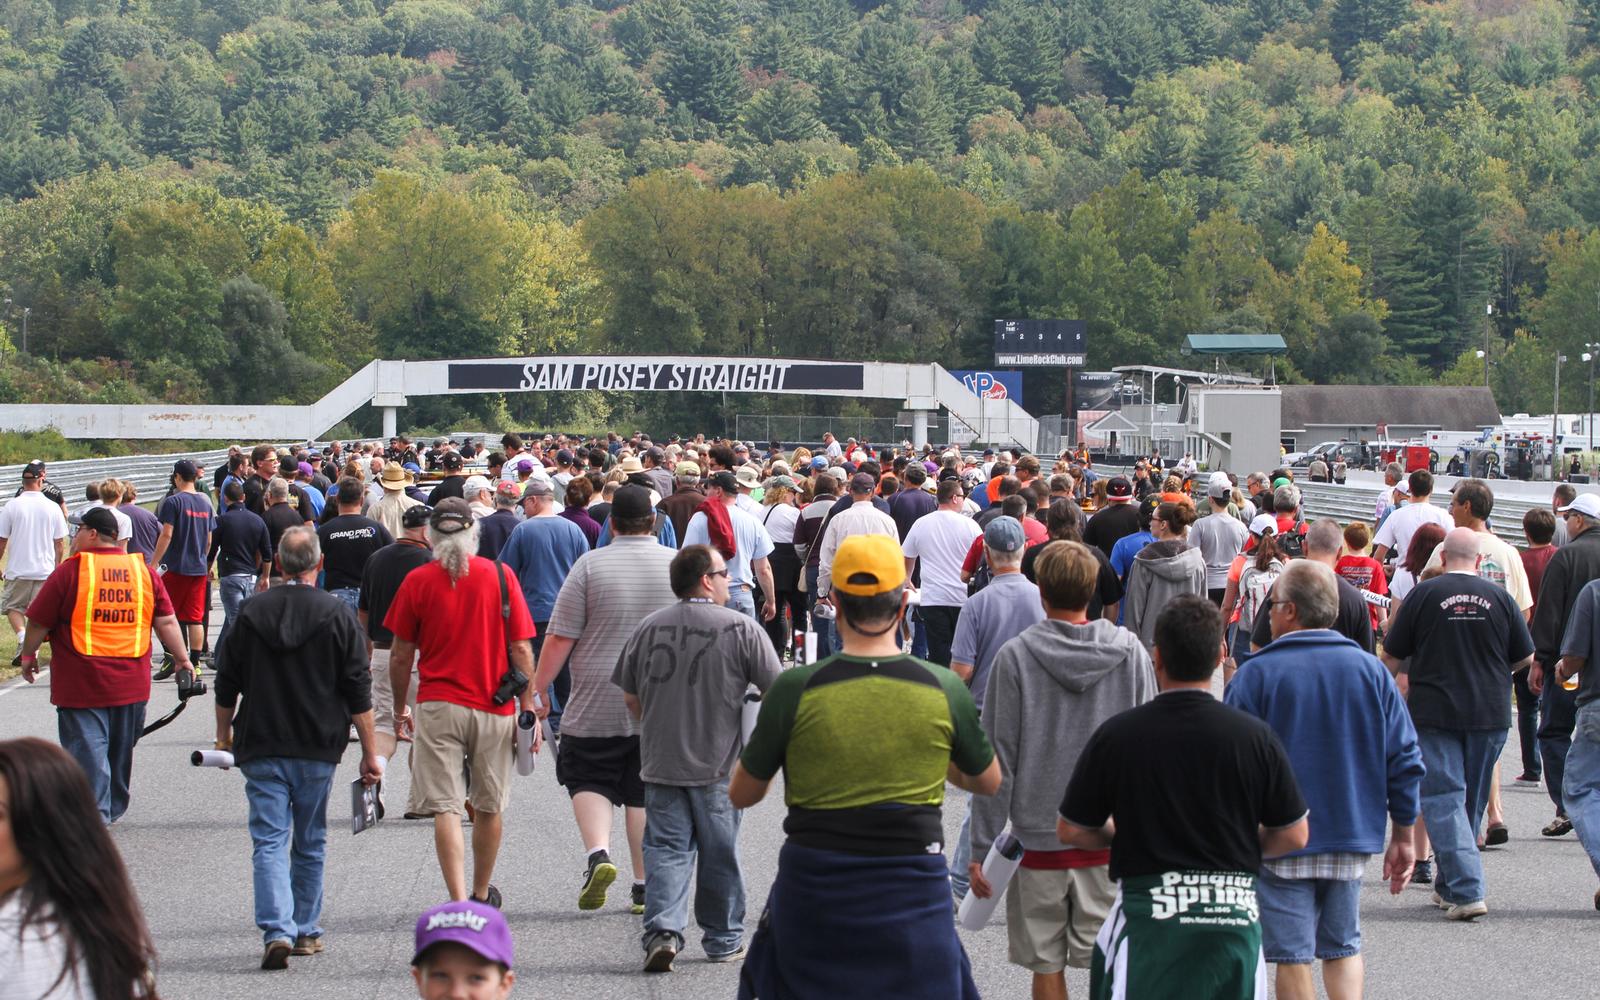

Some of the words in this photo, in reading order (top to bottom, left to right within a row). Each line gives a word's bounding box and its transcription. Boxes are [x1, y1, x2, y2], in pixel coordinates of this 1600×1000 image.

[998, 354, 1083, 365] www.LimeRockClub.com
[519, 363, 575, 390] SAM
[581, 363, 663, 391] POSEY
[668, 363, 791, 391] STRAIGHT
[330, 530, 355, 540] GRAND
[102, 568, 130, 583] LIME
[99, 588, 132, 603] ROCK
[1439, 594, 1492, 610] DWORKIN
[94, 608, 135, 623] PHOTO
[1149, 886, 1259, 923] Spring
